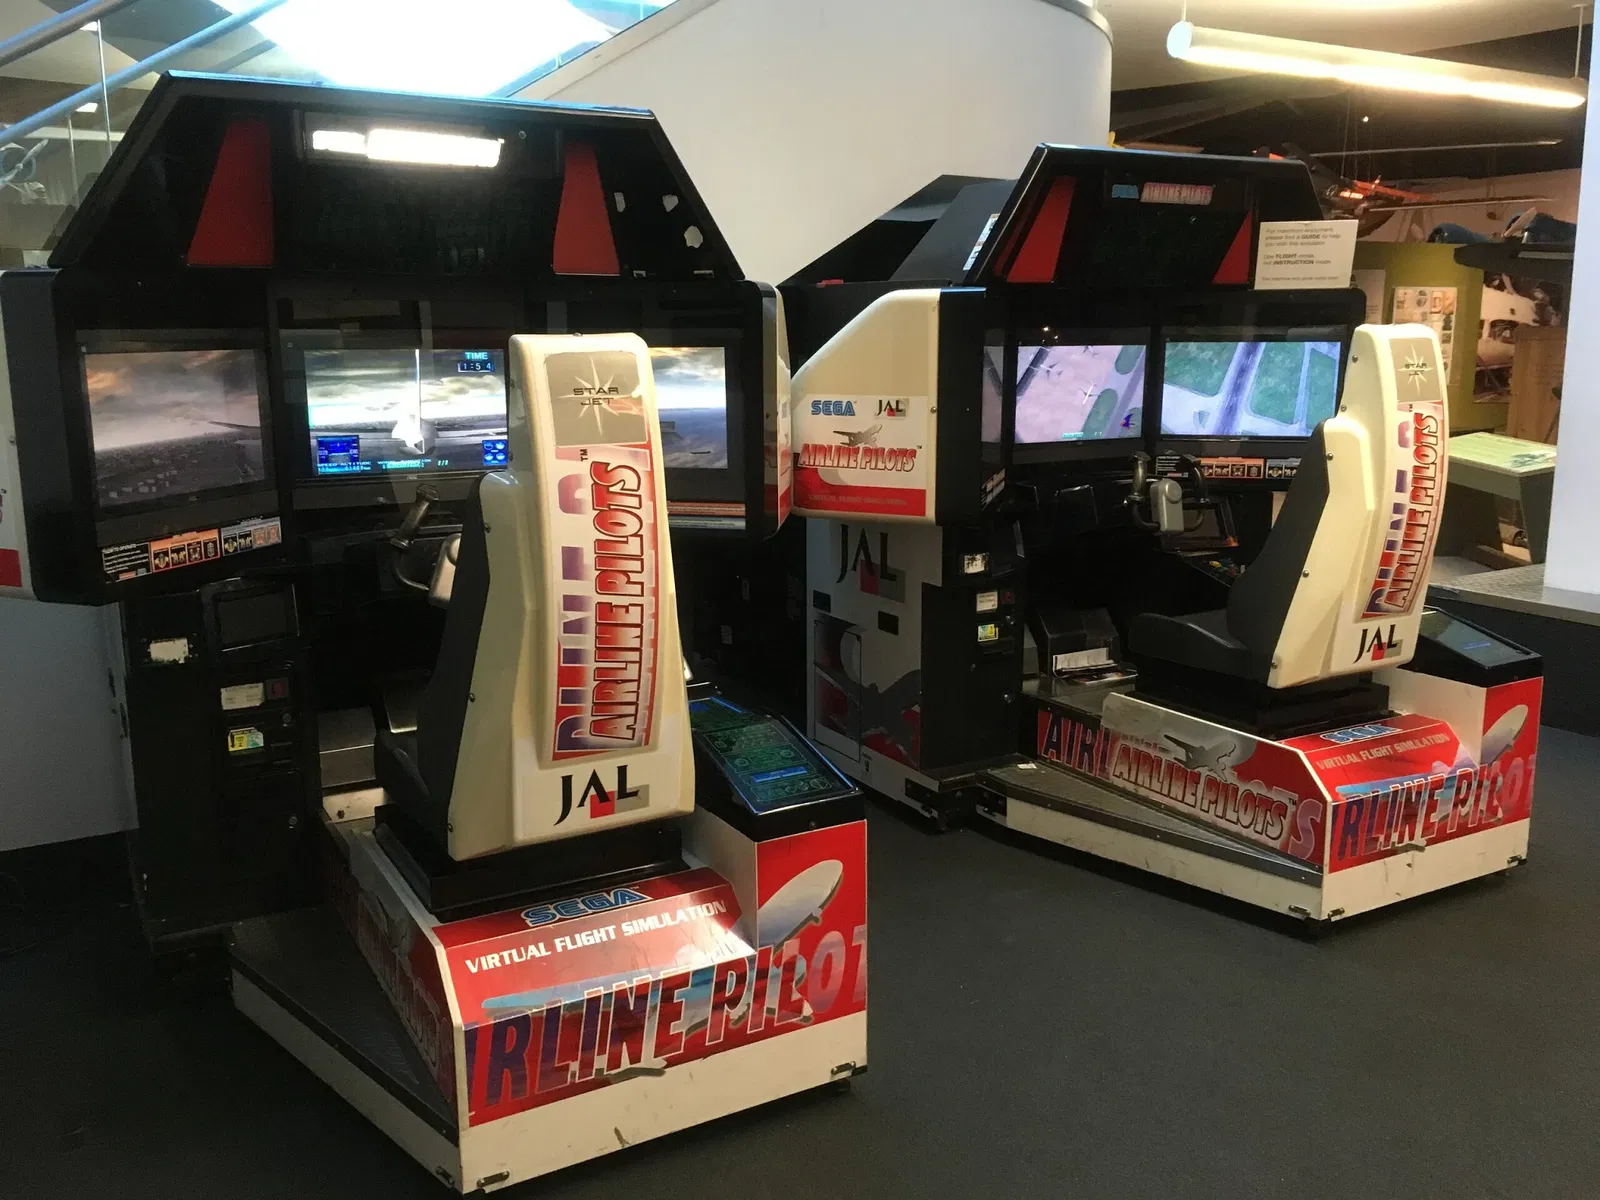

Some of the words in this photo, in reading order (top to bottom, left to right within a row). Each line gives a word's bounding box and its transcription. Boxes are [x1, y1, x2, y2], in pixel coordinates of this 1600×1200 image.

[464, 351, 489, 360] TIME
[573, 386, 619, 395] STAR
[580, 397, 614, 406] JET
[811, 400, 856, 416] SEGA
[875, 399, 903, 416] JAL
[798, 442, 860, 470] AIRLINE
[860, 446, 918, 473] PILOTS
[590, 461, 645, 598] PILOTS
[1384, 508, 1431, 608] AIRLINE
[1410, 412, 1440, 505] PILOTS
[836, 523, 898, 585] JAL
[1352, 623, 1399, 664] JAL
[589, 601, 645, 742] AIRLINE
[1316, 752, 1361, 770] VIRTUAL
[1360, 745, 1394, 761] FLIGHT
[1394, 732, 1451, 753] SIMULATION
[553, 764, 640, 827] JAL
[1111, 742, 1201, 809] AIRLINE
[1200, 774, 1289, 841] PILOTS
[521, 887, 653, 926] SEGA
[465, 946, 552, 975] VIRTUAL
[554, 925, 617, 953] FLIGHT
[621, 899, 728, 936] SIMULATION
